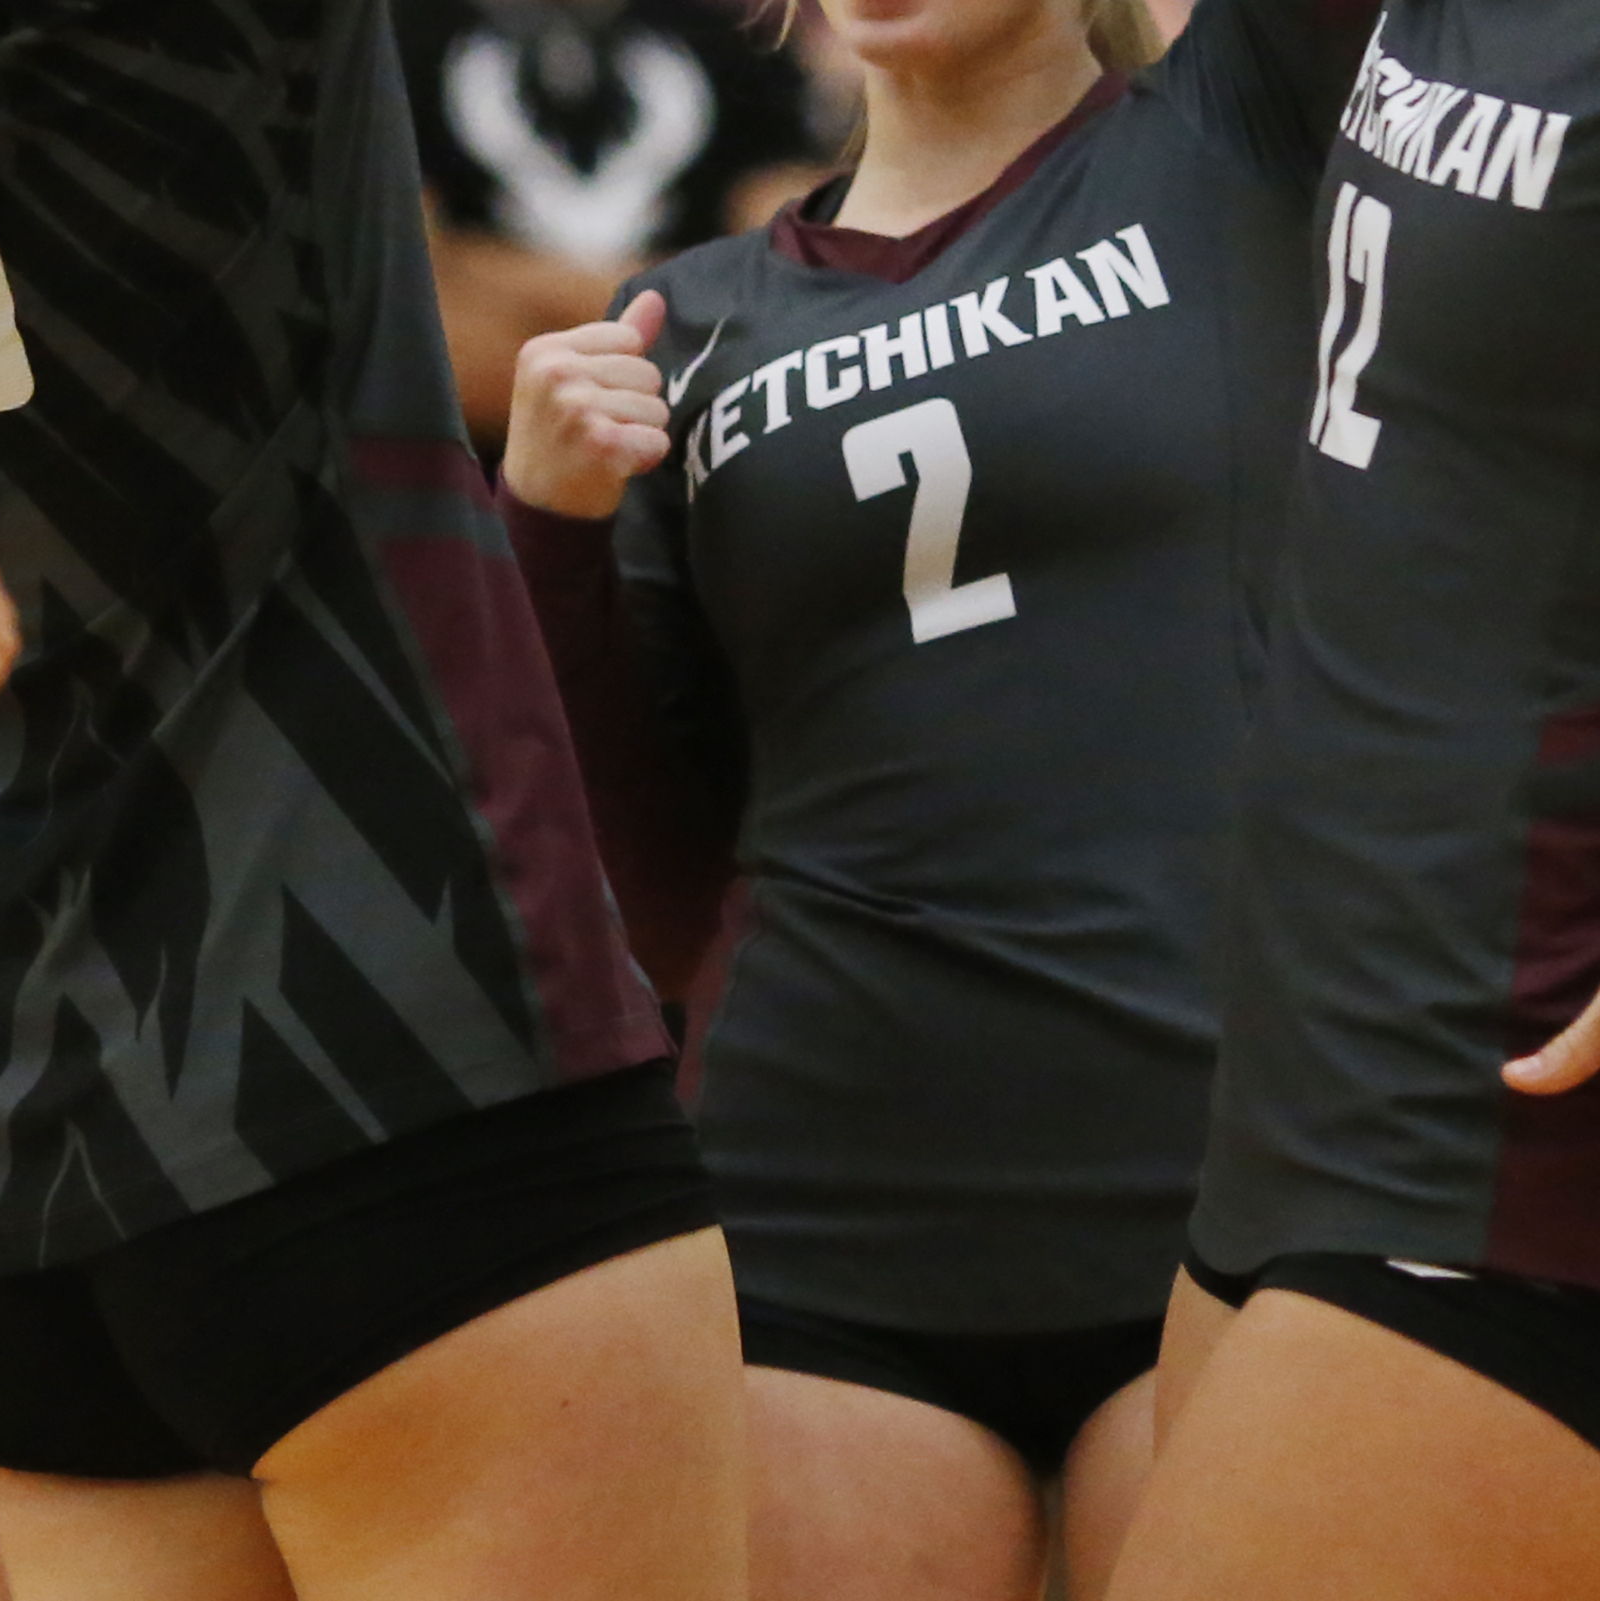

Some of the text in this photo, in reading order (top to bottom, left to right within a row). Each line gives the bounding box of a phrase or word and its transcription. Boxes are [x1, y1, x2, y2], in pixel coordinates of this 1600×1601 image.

[684, 223, 1170, 504] KETCHIKAN
[1308, 181, 1393, 471] 12
[841, 397, 1017, 644] 2
